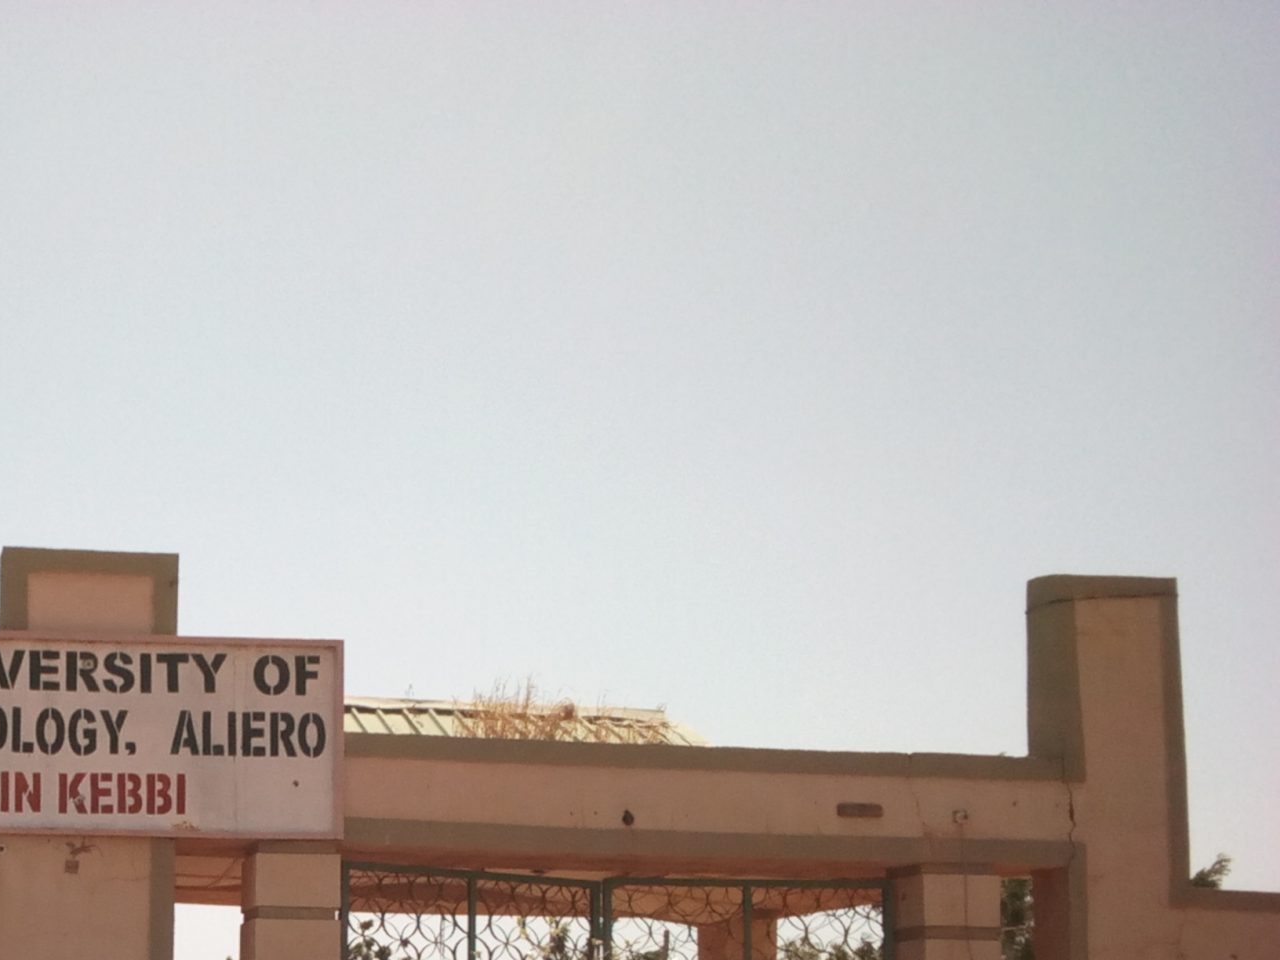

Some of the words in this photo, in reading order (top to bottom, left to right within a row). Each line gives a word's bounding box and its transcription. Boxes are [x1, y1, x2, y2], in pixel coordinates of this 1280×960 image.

[254, 655, 320, 695] OF
[171, 710, 325, 757] ALIERO
[59, 773, 185, 814] KEBBI
